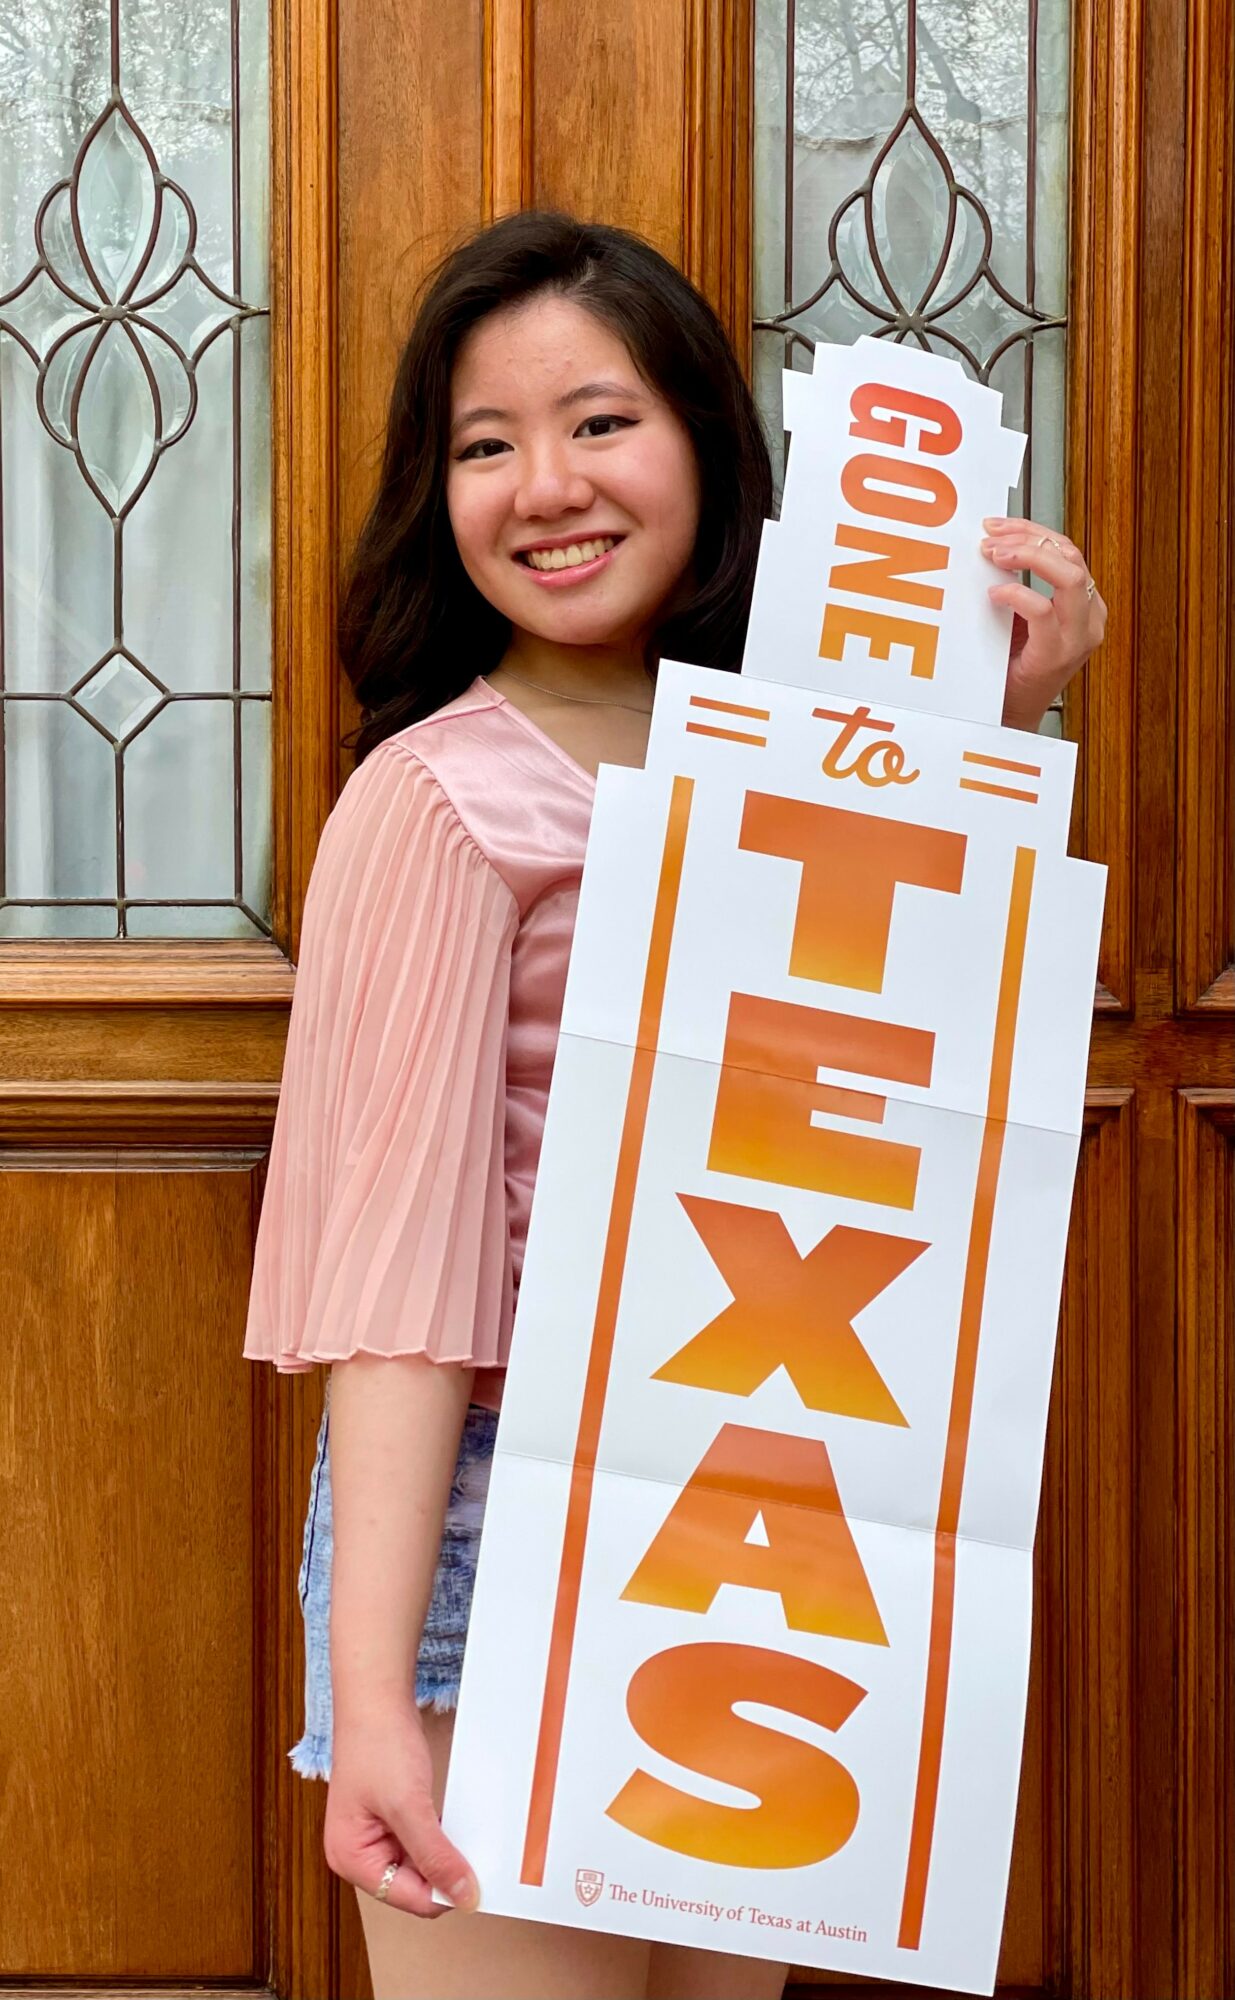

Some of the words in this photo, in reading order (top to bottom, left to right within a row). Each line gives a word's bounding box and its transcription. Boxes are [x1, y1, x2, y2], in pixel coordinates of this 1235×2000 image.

[819, 382, 962, 680] GONE
[812, 706, 920, 788] to
[605, 790, 968, 1870] TEXAS
[608, 1883, 637, 1903] The
[642, 1889, 724, 1922] University
[726, 1905, 745, 1921] of
[748, 1907, 792, 1930] Texas
[796, 1918, 812, 1933] at
[815, 1919, 868, 1943] Austin
